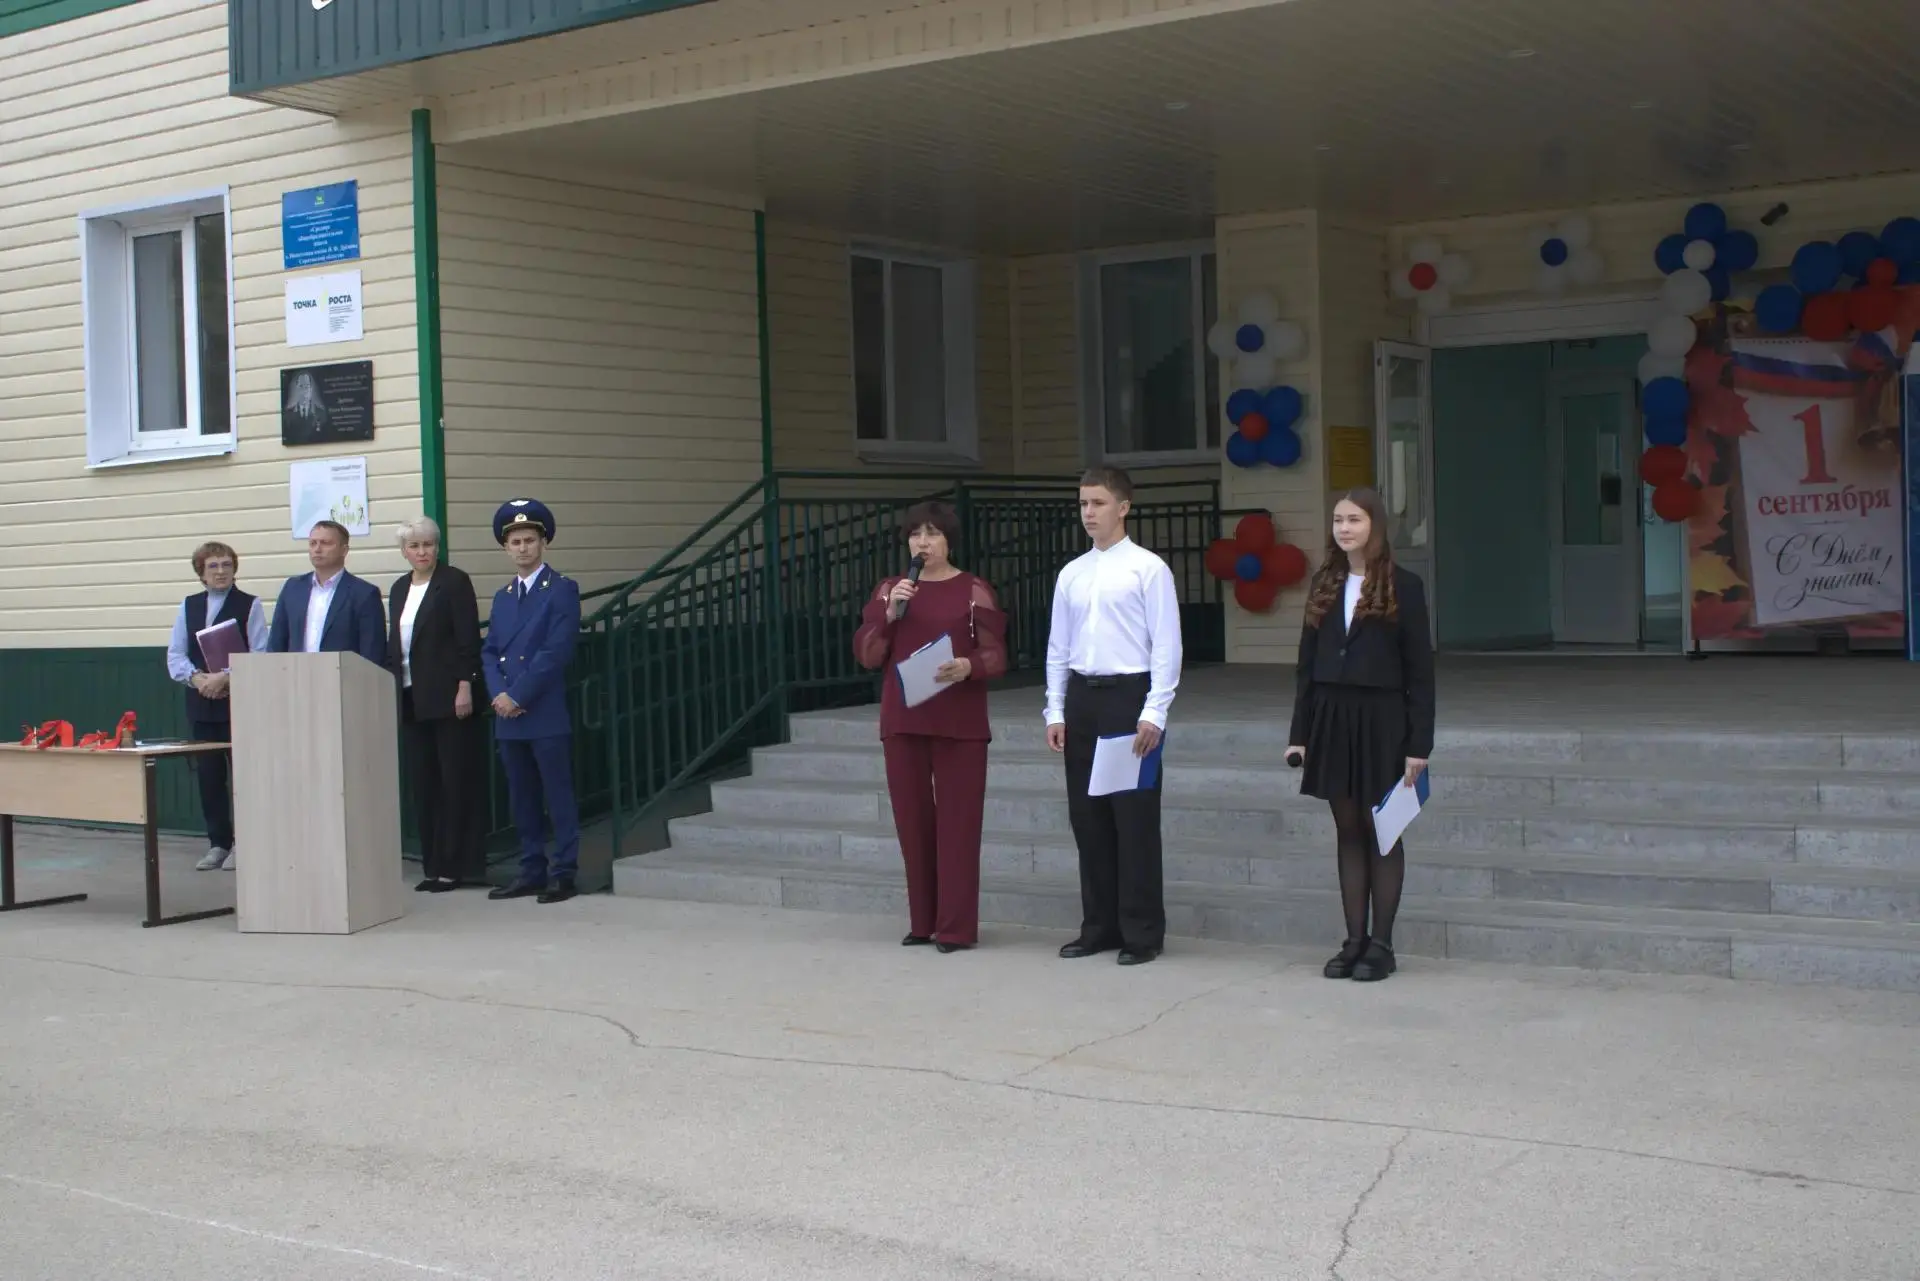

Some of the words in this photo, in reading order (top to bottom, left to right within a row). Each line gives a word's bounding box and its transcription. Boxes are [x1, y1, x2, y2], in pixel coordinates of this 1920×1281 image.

[293, 299, 317, 309] ТОЧКА
[328, 294, 352, 305] РОСТА
[1792, 403, 1837, 484] 1
[1758, 484, 1892, 517] сентября
[1765, 533, 1807, 575] С
[1812, 533, 1884, 567] Днём
[1773, 555, 1892, 611] знаний!
